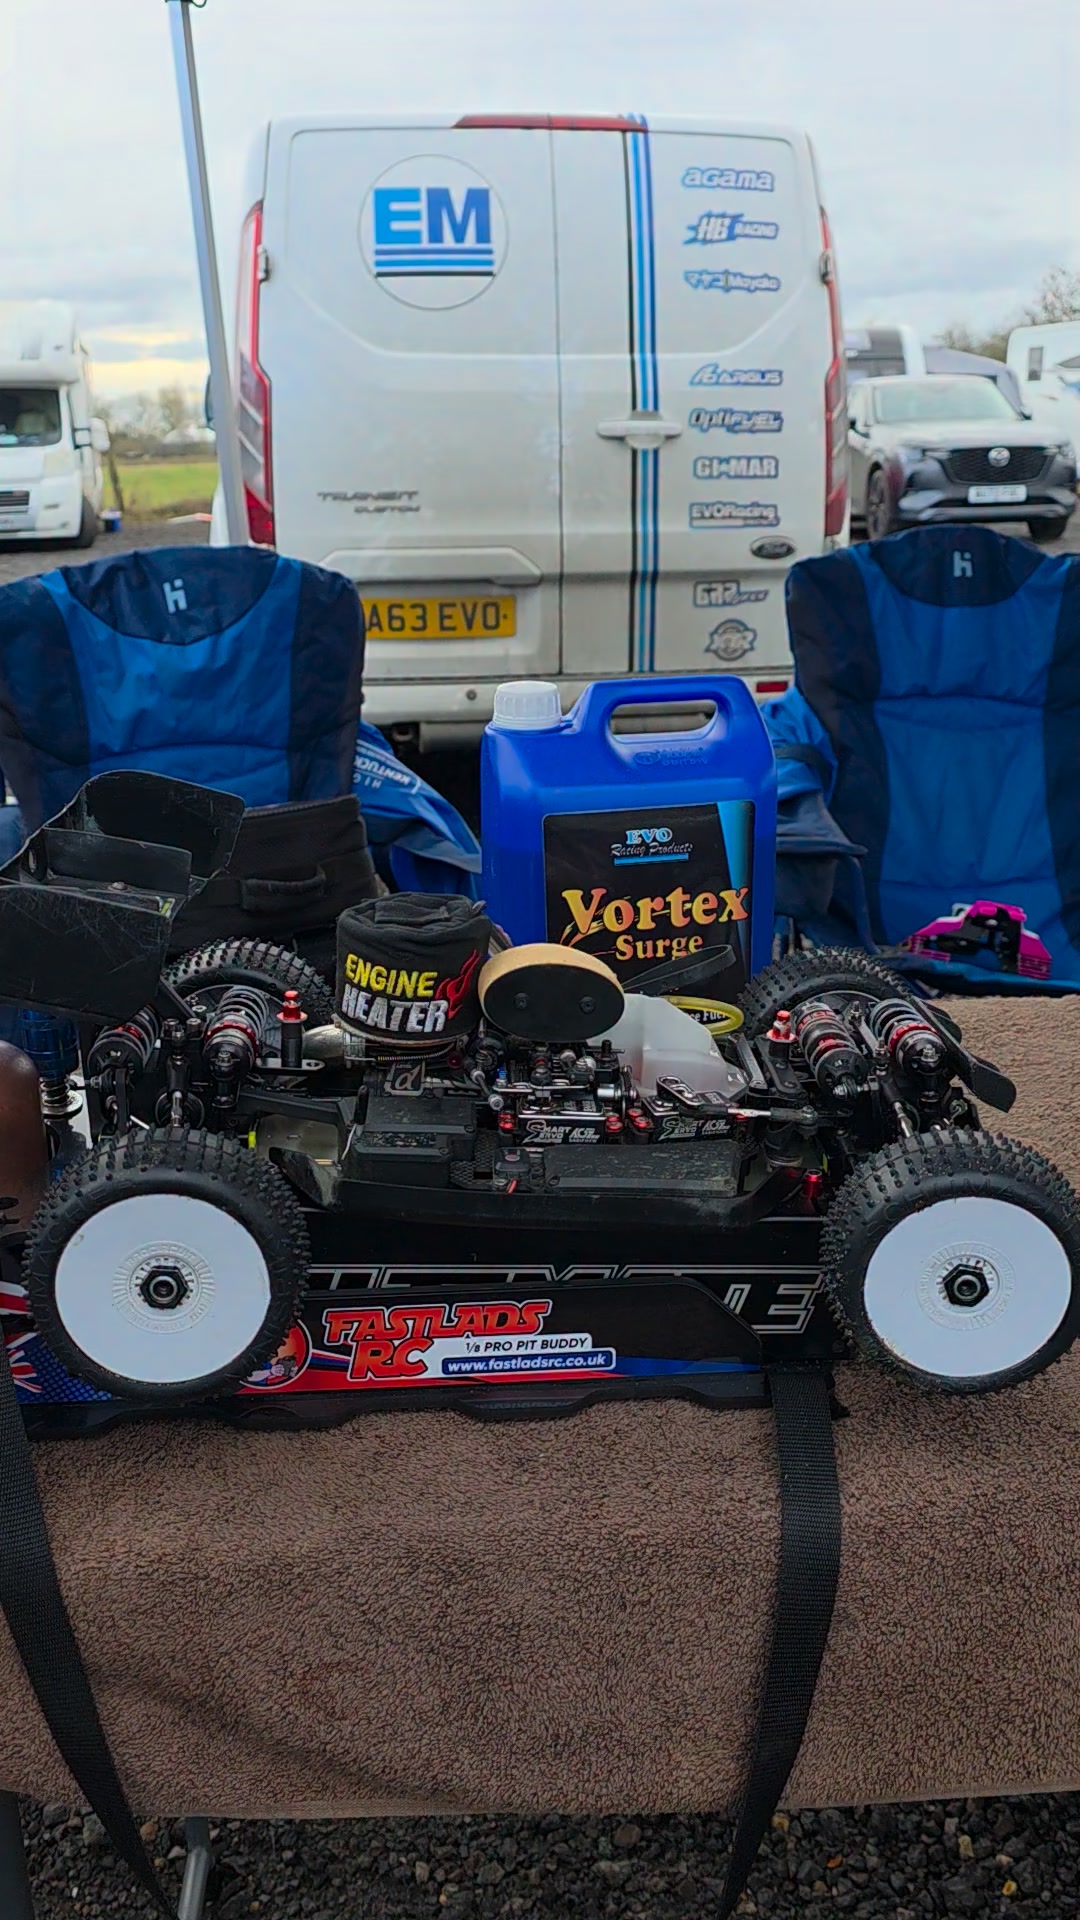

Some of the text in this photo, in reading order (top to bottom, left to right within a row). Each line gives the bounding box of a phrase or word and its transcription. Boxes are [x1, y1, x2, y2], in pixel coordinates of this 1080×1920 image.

[373, 187, 492, 245] EM
[438, 601, 501, 632] EVO
[610, 841, 694, 858] Racing Products
[625, 827, 673, 845] EVO
[561, 886, 749, 935] Vortex
[615, 934, 704, 962] Surge
[344, 953, 439, 999] ENGINE
[341, 983, 449, 1033] HEATER
[324, 1302, 551, 1342] FASTLADS
[350, 1336, 434, 1379] RC
[483, 1341, 513, 1352] PRO
[516, 1340, 538, 1351] PIT
[540, 1337, 589, 1350] BUDDY
[447, 1353, 607, 1373] www.fastladsrc.co.uk
